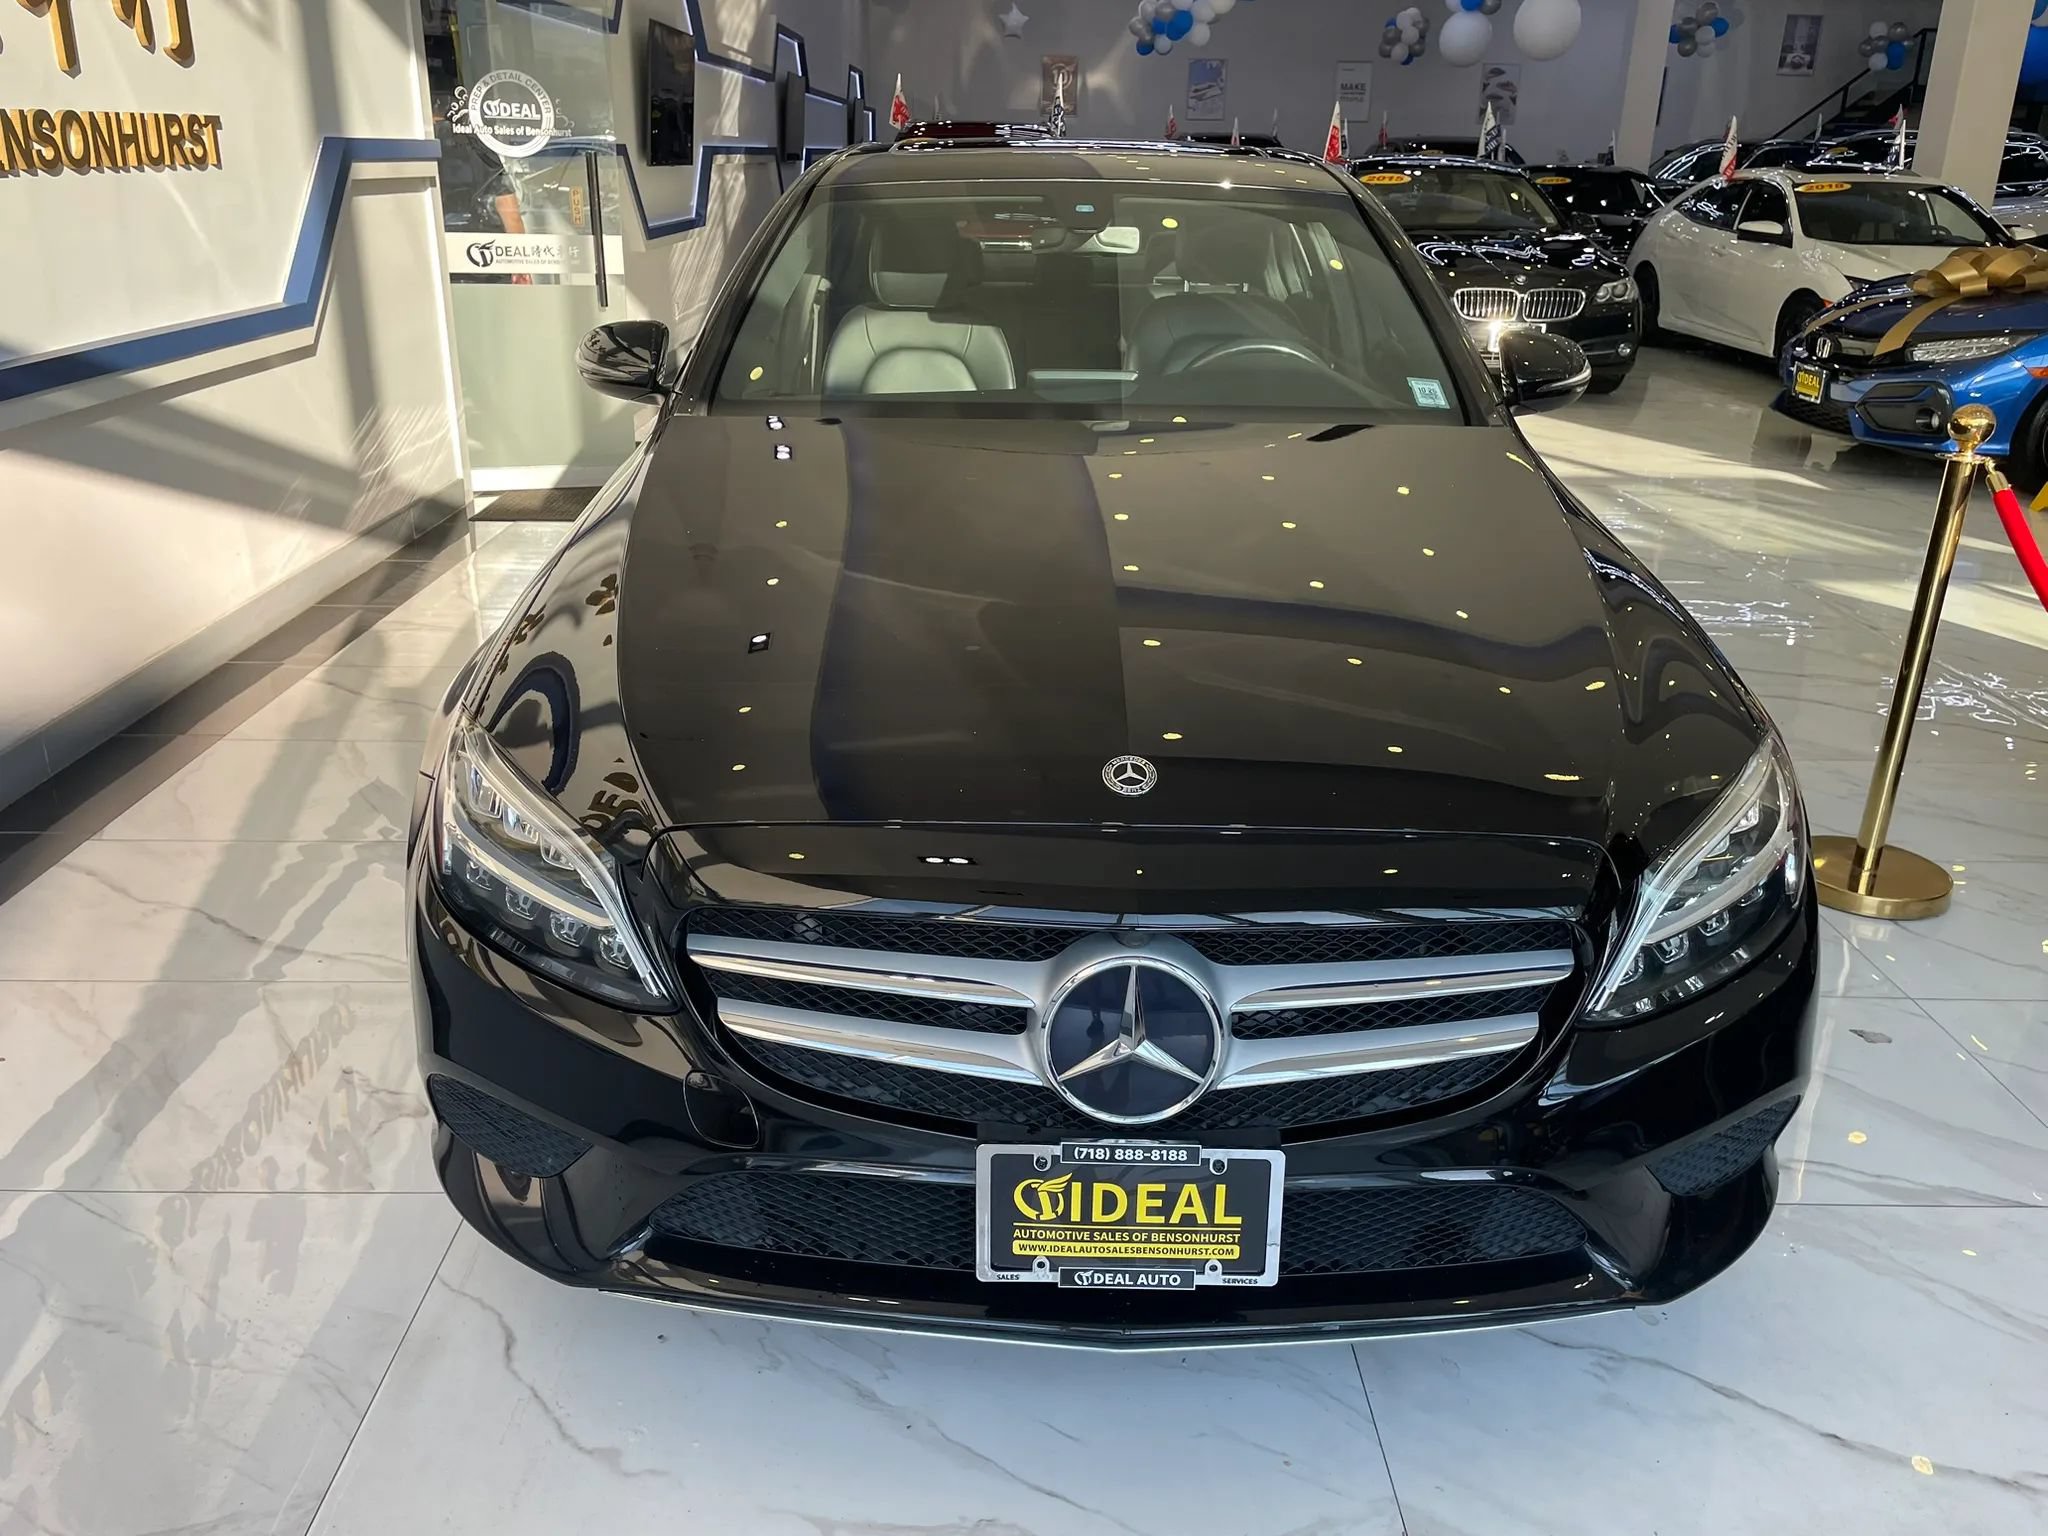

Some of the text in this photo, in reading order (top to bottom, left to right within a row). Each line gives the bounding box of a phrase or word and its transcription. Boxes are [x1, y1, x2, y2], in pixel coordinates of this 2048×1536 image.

[470, 85, 483, 111] PREP
[489, 71, 523, 83] DETAIL
[524, 79, 552, 114] CENTER
[452, 123, 473, 135] Ideal
[494, 124, 515, 136] Sales
[515, 125, 525, 136] of
[0, 109, 223, 176] NSONHURST
[572, 188, 581, 225] PUSH
[1074, 1146, 1188, 1162] (718) 888-8188
[1070, 1181, 1243, 1225] IDEAL
[1013, 1228, 1241, 1244] AUTOMOTIVE SALES OF BENSONHURST
[1018, 1243, 1234, 1257] WWW.IDEALAUTOSALESBENSONHURST.COM
[996, 1273, 1020, 1281] SALES
[1136, 1273, 1182, 1287] AUTO
[1222, 1277, 1258, 1286] SERVICES
